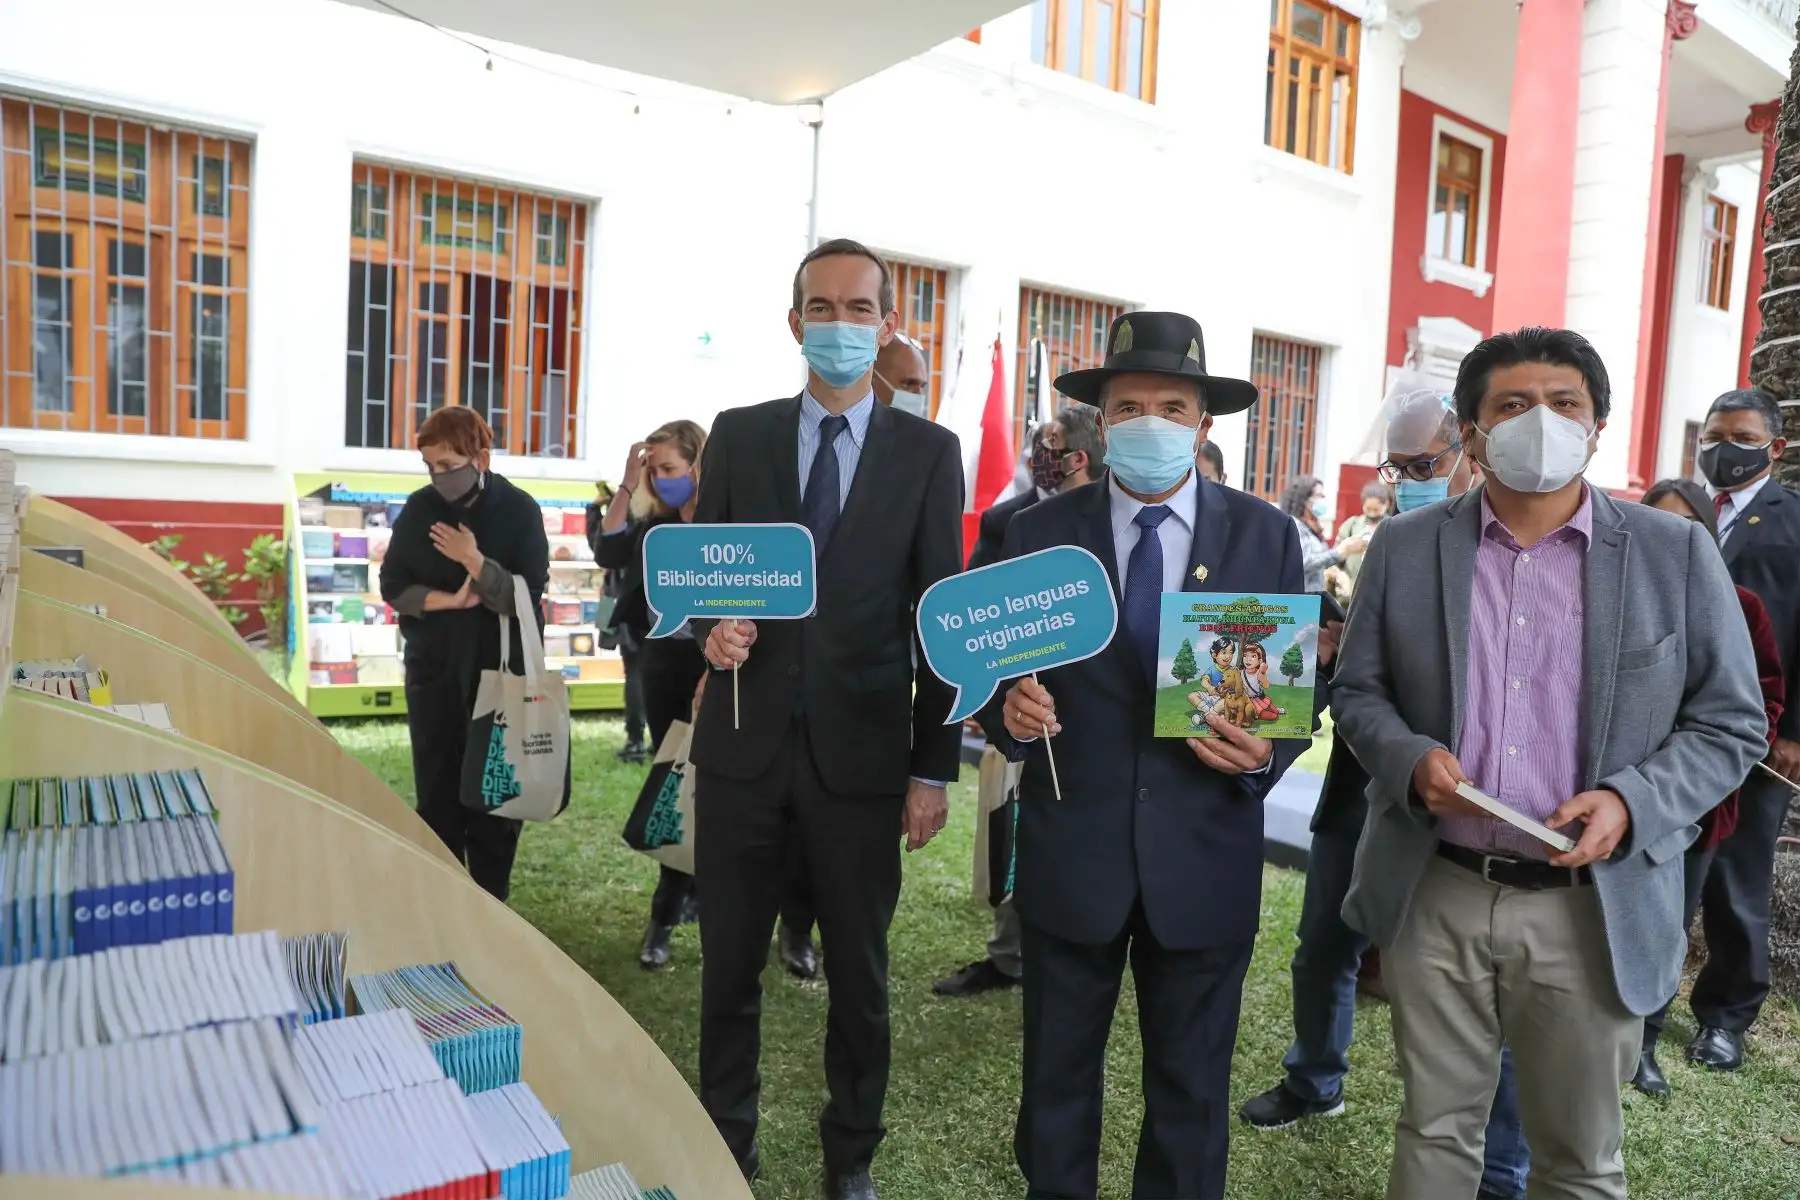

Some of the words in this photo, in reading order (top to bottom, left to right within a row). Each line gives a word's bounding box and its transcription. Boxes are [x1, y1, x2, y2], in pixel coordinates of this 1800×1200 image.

[701, 543, 755, 565] 100%
[657, 570, 803, 587] Bibliodiversidad
[694, 599, 704, 607] LA
[705, 599, 767, 607] INDEPENDIENTE
[936, 612, 963, 632] Yo
[967, 604, 1001, 625] leo
[1004, 579, 1090, 611] lenguas
[1191, 603, 1242, 613] GRANDES
[1245, 604, 1289, 613] AMIGOS
[965, 611, 1076, 653] originarias
[1199, 624, 1227, 632] BEST
[1229, 624, 1278, 633] FRIENDS
[985, 660, 998, 670] LA
[998, 641, 1067, 667] INDEPENDIENTE
[491, 724, 505, 744] IN
[488, 742, 507, 760] DE
[485, 759, 516, 780] PEN
[482, 775, 521, 796] DIEN
[481, 790, 504, 807] TE
